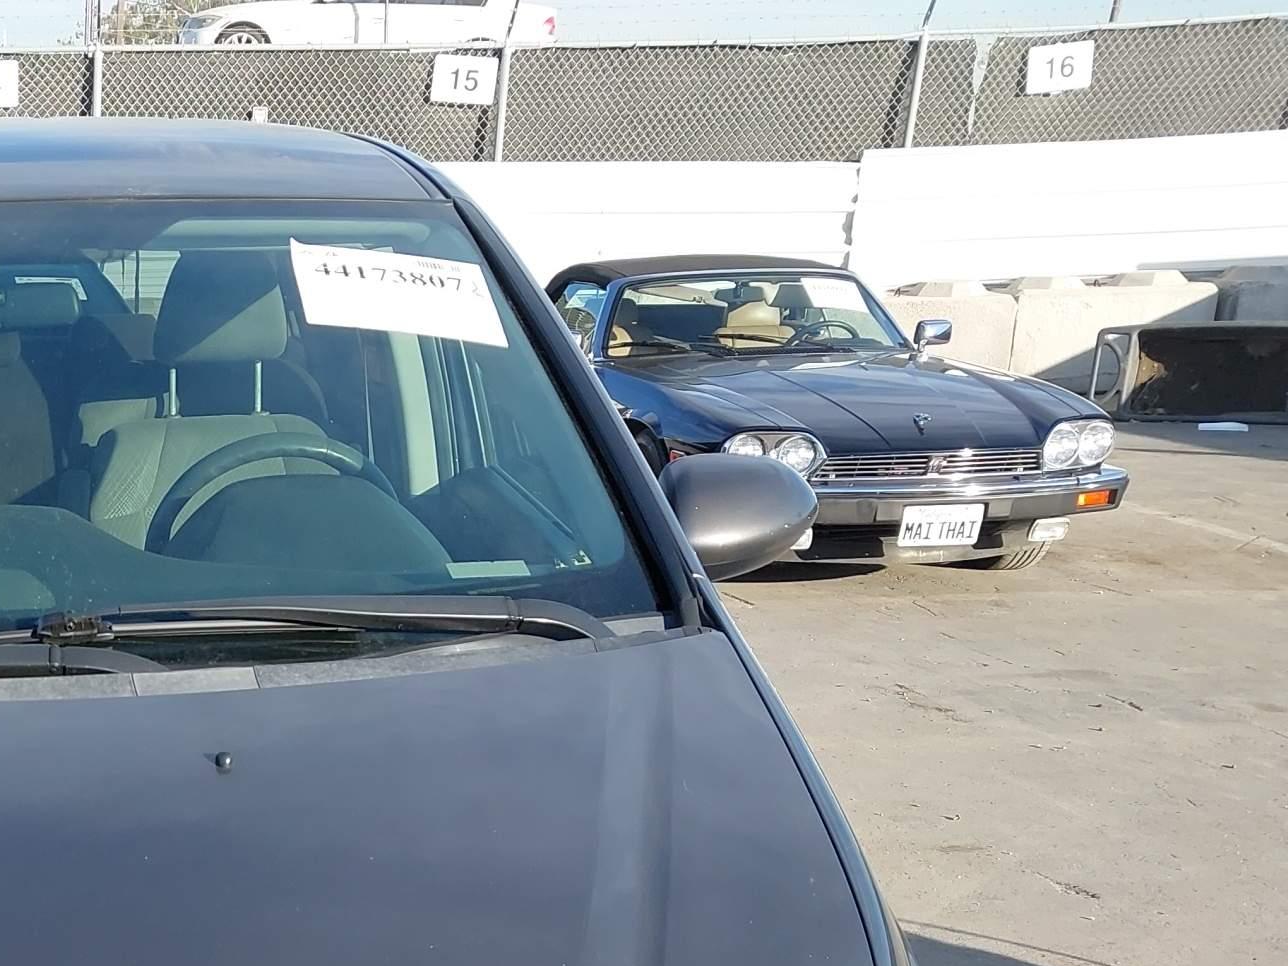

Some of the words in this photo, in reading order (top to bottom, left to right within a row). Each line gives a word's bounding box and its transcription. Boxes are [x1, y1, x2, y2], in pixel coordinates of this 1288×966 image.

[1046, 55, 1075, 79] 16
[451, 68, 479, 91] 15
[314, 262, 462, 291] 44173807
[902, 522, 934, 540] MAI
[938, 520, 977, 540] THAI
